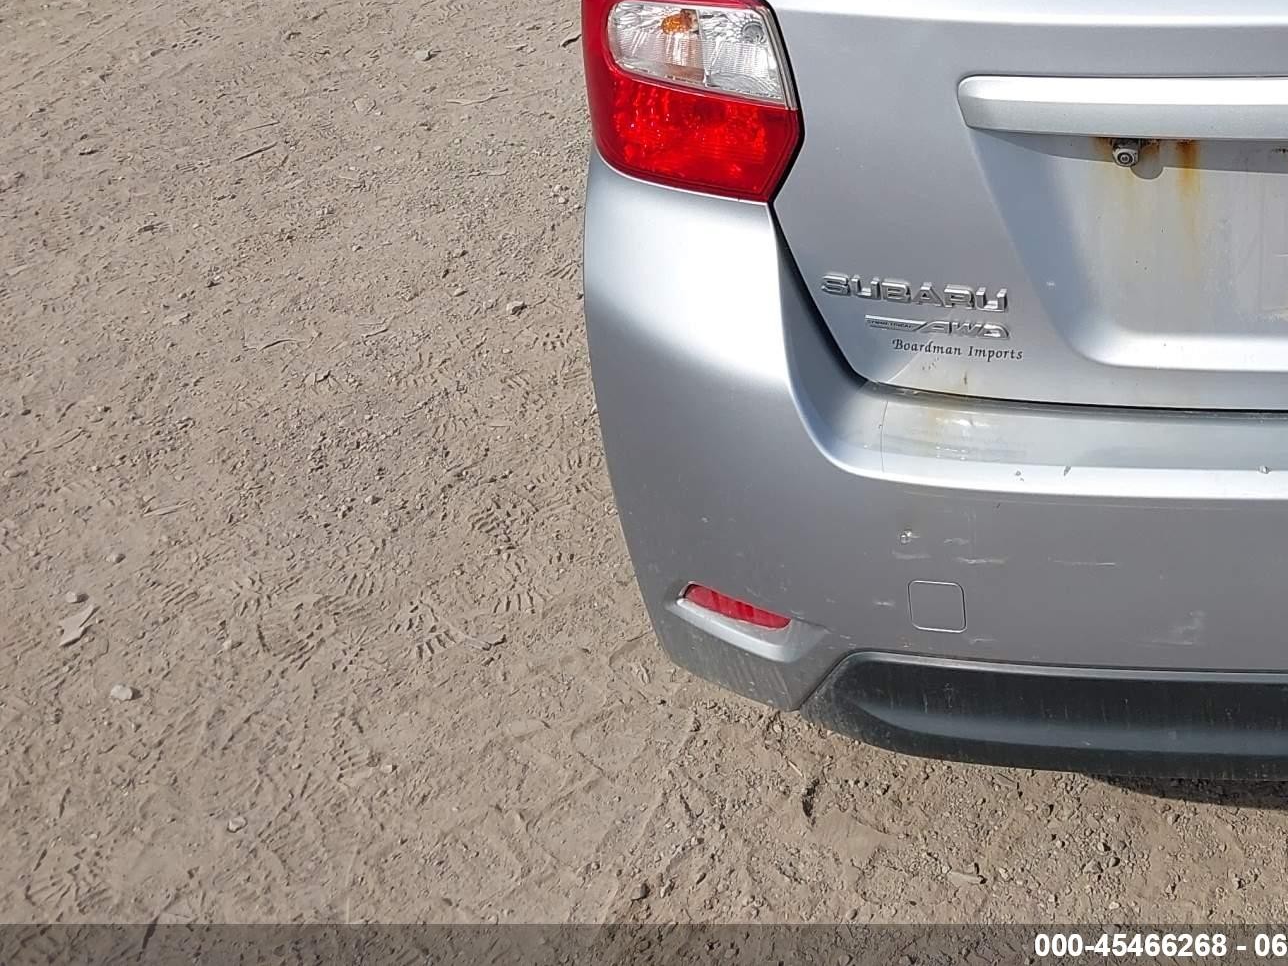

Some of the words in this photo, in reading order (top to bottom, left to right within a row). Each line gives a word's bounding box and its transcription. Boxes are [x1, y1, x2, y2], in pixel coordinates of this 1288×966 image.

[820, 272, 1009, 313] SUBARU
[917, 320, 1010, 340] AWD
[892, 338, 962, 356] Boardman
[968, 345, 1023, 362] Imports
